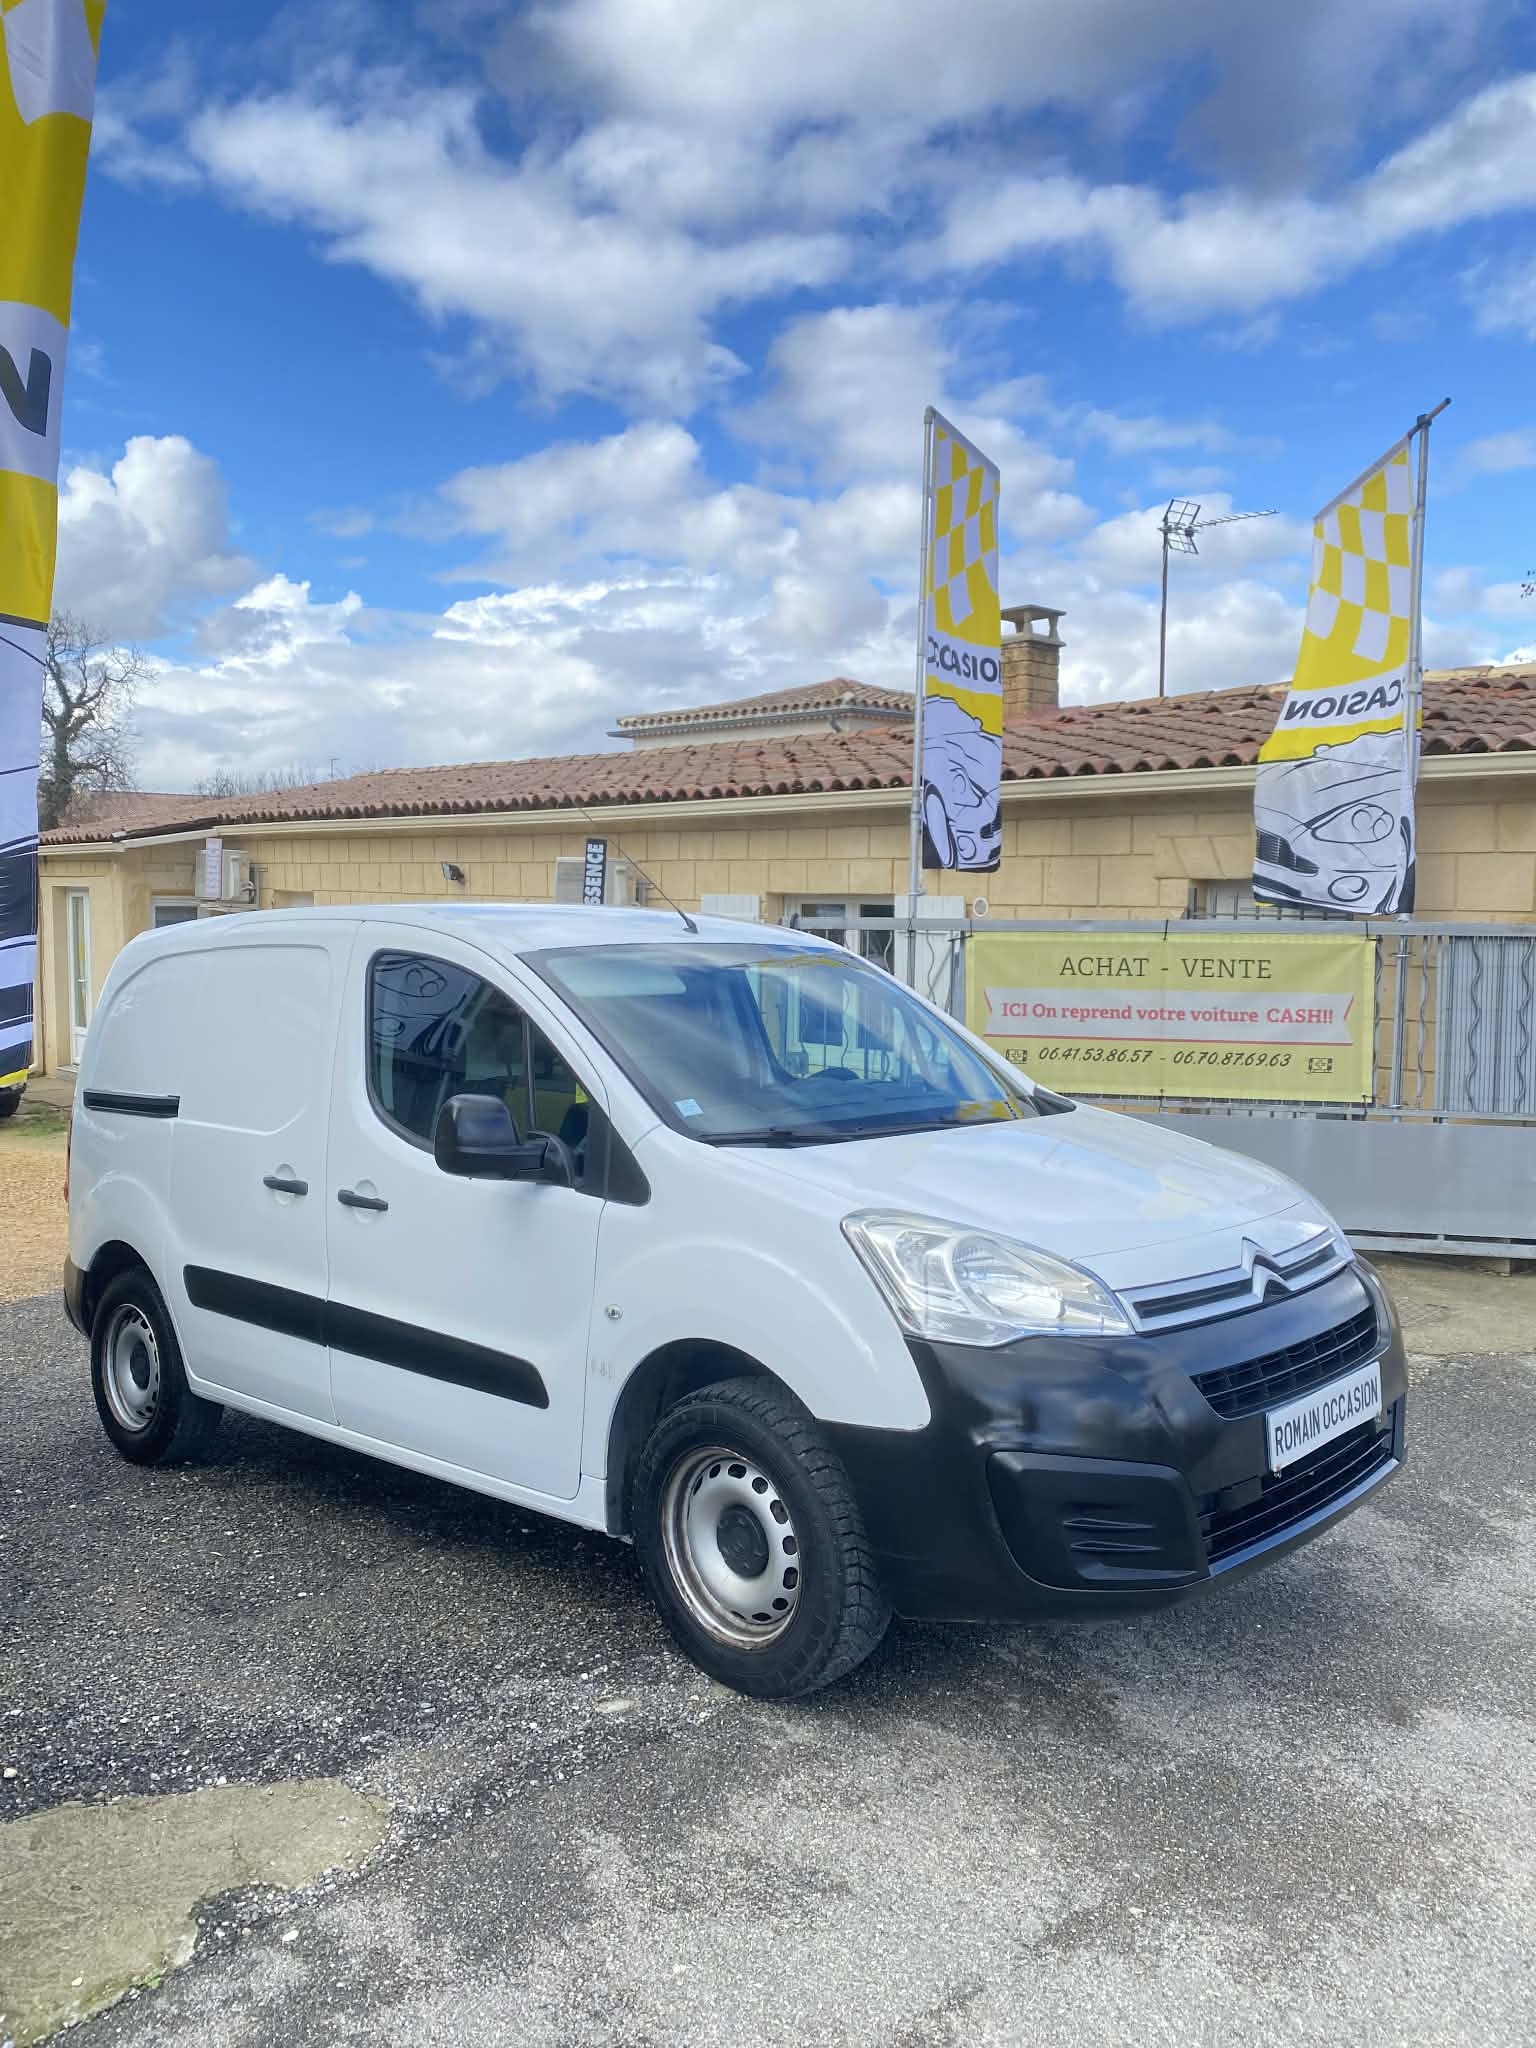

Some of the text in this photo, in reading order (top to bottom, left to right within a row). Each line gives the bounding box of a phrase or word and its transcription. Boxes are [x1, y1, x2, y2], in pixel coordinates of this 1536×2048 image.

[1059, 957, 1150, 977] ACHAT
[1181, 958, 1273, 979] VENTE
[1001, 1002, 1333, 1024] ICI On reprend votre voiture CASH!!
[1173, 1050, 1292, 1067] 06.70.87.69.63
[1275, 1376, 1378, 1456] ROMAIN OCCASION
